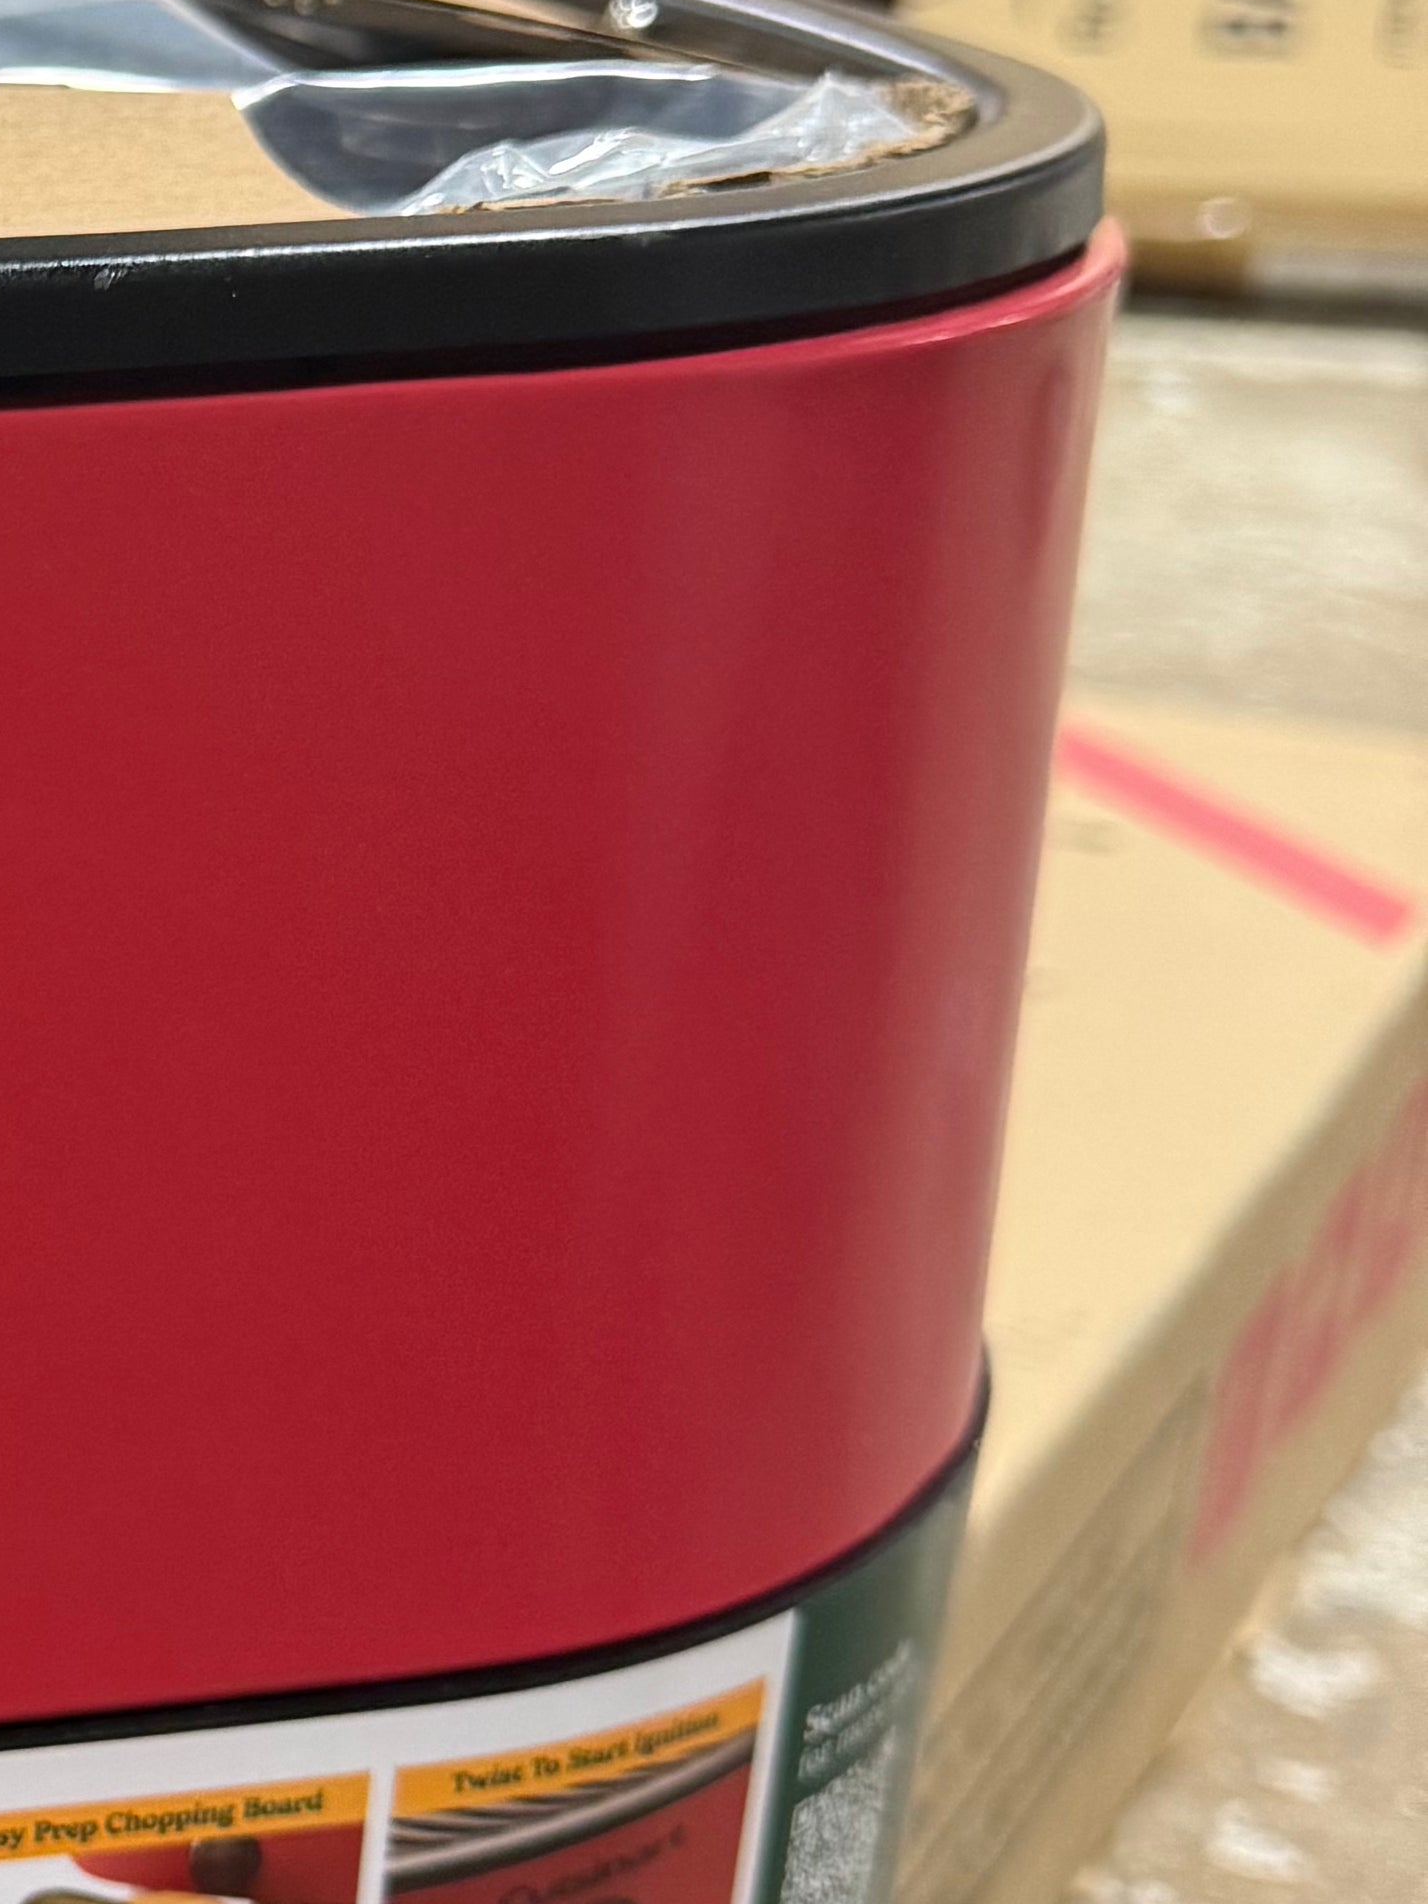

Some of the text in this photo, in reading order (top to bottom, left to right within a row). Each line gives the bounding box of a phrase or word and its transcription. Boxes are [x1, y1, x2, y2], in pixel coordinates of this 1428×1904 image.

[450, 1764, 522, 1793] Twist
[530, 1754, 561, 1779] To
[566, 1739, 630, 1770] Start
[33, 1819, 98, 1843] Prep
[104, 1802, 235, 1833] Chopping
[243, 1788, 325, 1819] Board
